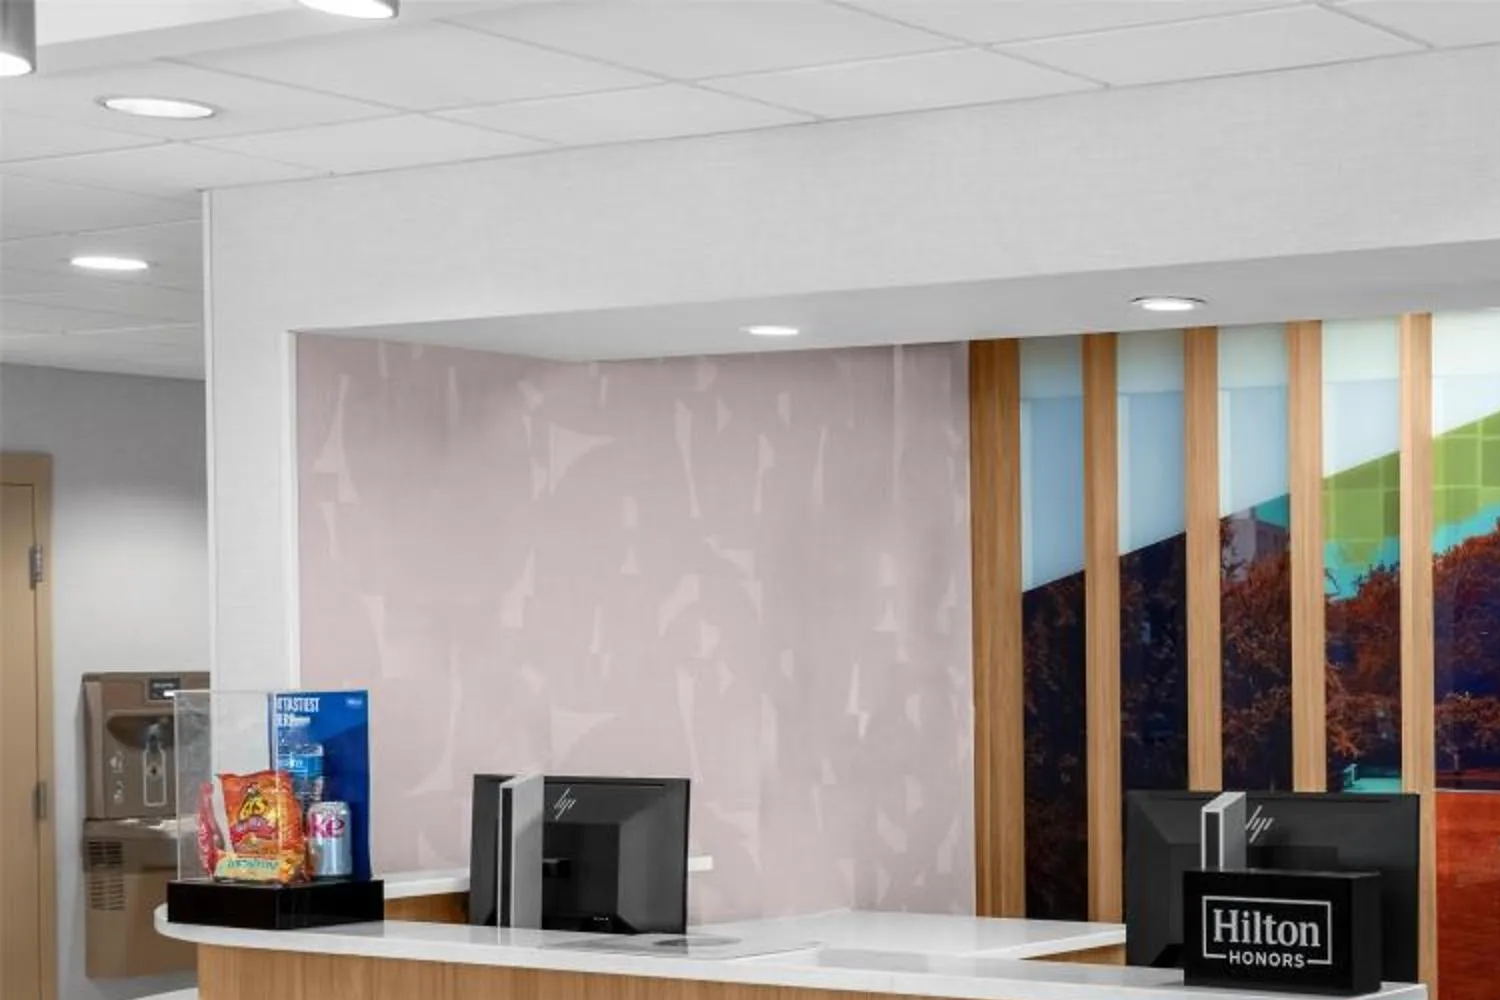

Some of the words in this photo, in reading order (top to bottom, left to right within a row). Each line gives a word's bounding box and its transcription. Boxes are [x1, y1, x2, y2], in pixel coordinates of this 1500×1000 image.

[1245, 804, 1275, 843] hp
[1213, 908, 1321, 948] Hilton
[1229, 950, 1306, 968] HONORS
